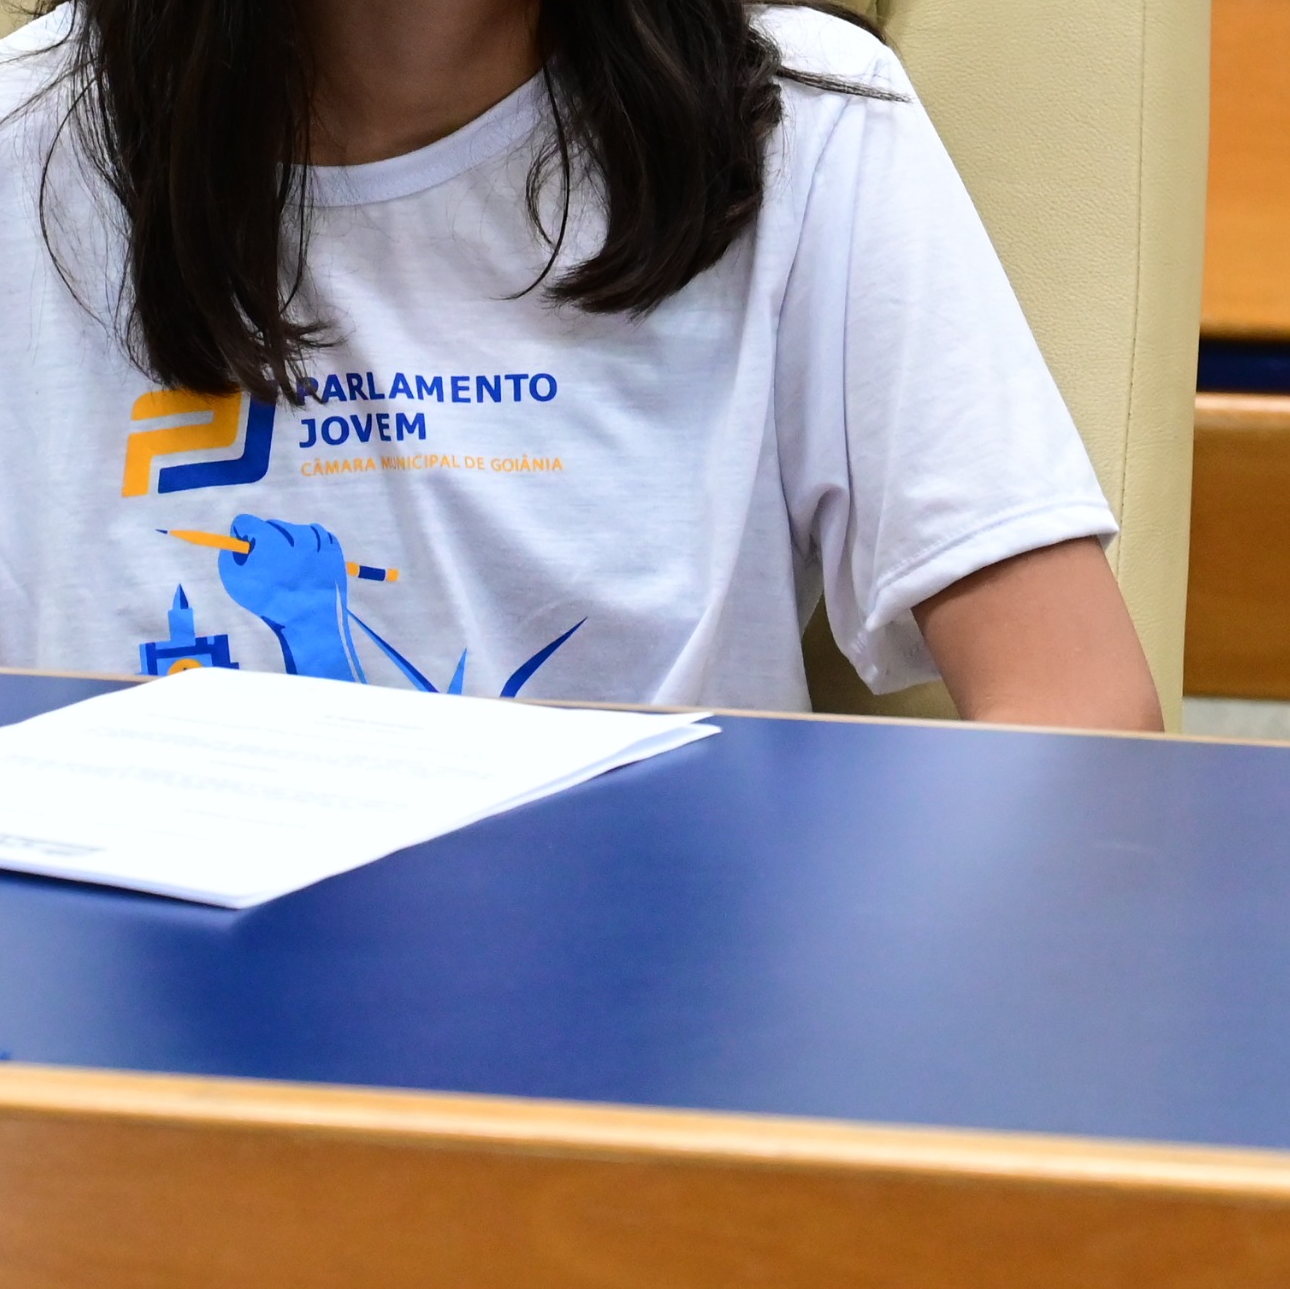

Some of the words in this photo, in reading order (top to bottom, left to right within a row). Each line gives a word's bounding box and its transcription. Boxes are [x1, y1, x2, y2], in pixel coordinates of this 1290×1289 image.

[296, 371, 558, 403] PARLAMENTO
[299, 412, 427, 448] JOVEM
[301, 456, 376, 477] CÂMARA
[382, 454, 460, 471] MUNICIPAL
[465, 455, 486, 471] DE
[491, 454, 563, 472] GOIÂNIA
